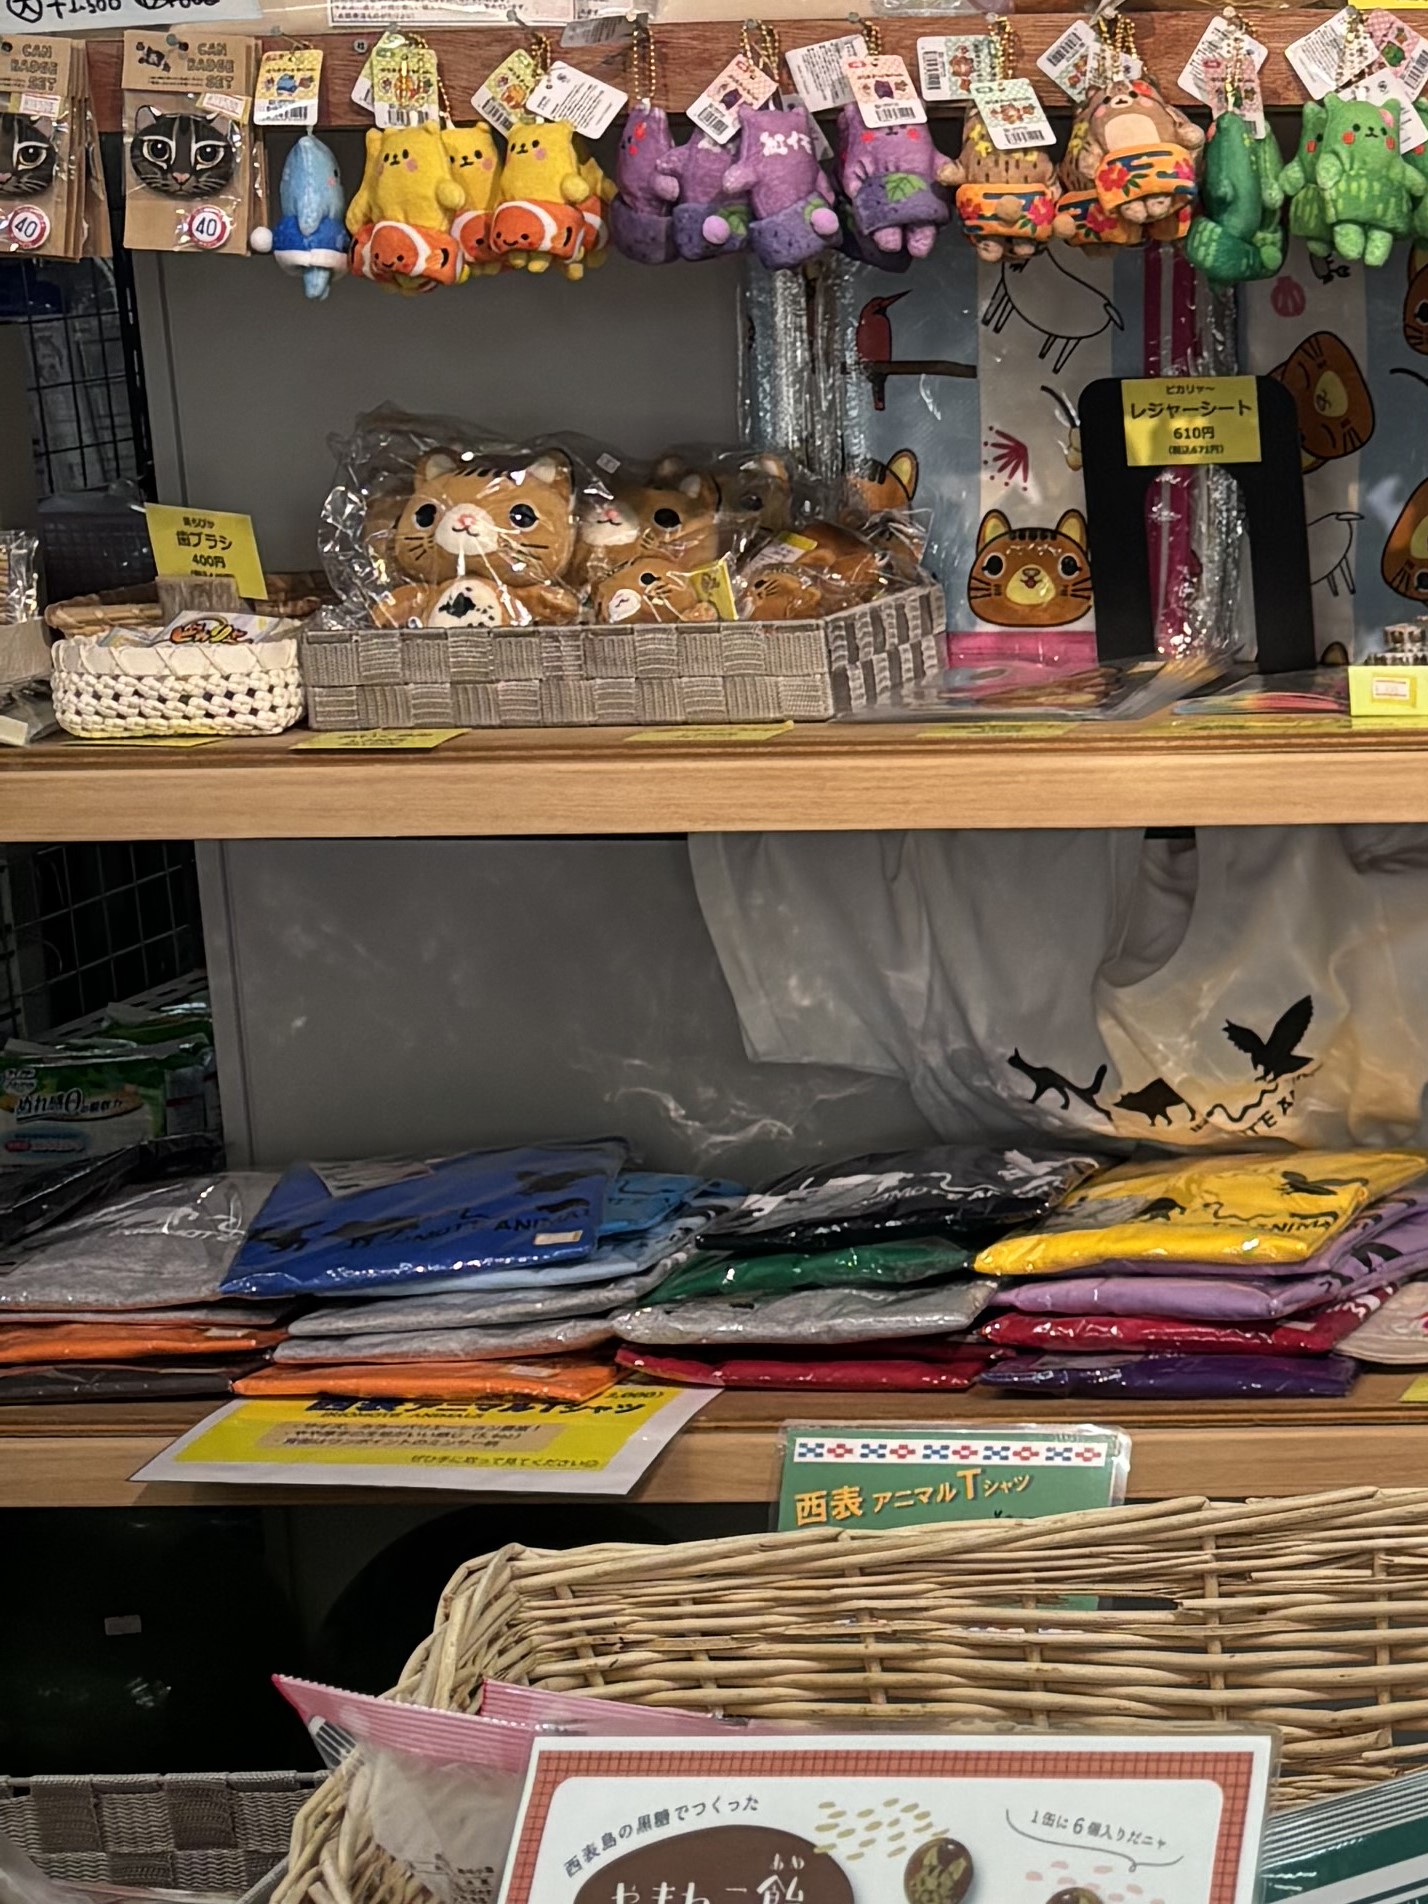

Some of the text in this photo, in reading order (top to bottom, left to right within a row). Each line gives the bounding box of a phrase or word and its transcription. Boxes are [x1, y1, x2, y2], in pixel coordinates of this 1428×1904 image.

[14, 217, 37, 239] 40
[196, 217, 219, 238] 40
[1130, 399, 1253, 419] レジャーシート
[1173, 426, 1215, 440] 610円
[176, 530, 233, 551] 歯ブラシ
[192, 553, 227, 568] 400円
[795, 1468, 1030, 1526] 西表 アニマルTシャツ
[563, 1793, 761, 1880] 西表島の黒糖でつくった
